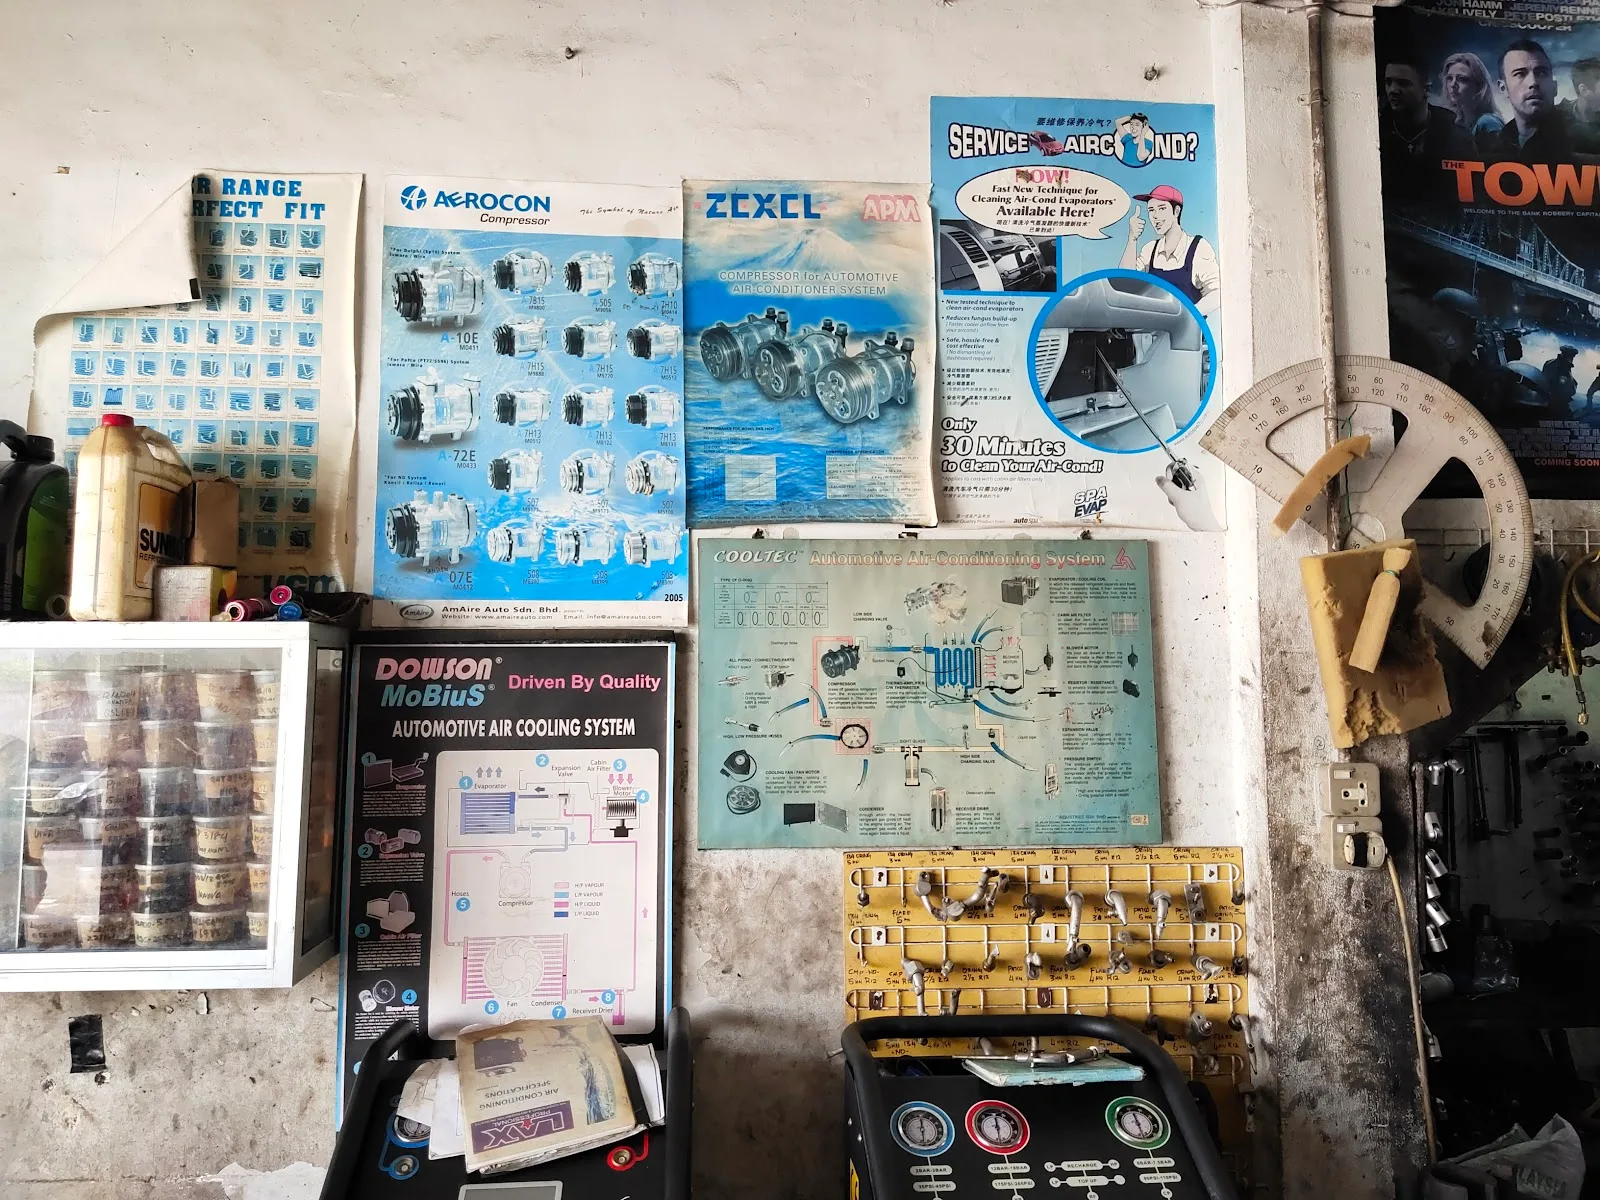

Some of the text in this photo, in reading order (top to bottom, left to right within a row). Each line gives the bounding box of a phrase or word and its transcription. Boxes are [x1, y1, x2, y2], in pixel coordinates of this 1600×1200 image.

[949, 122, 1030, 160] SERVICE
[1444, 161, 1465, 169] THE
[222, 178, 302, 198] RANGE
[1442, 160, 1600, 206] TOW
[992, 185, 1099, 196] Fast New Technique for
[433, 191, 551, 213] AEROCON
[971, 195, 1012, 205] Cleaning
[1013, 195, 1057, 205] Air-Cond
[284, 202, 326, 220] FIT
[862, 194, 922, 222] APM
[996, 206, 1095, 218] Available Here!
[480, 214, 551, 226] Compressor
[719, 271, 899, 283] COMPRESSOR for AUTOMOTIVE
[732, 285, 887, 296] AIR-CONDITIONER SYSTEM
[971, 315, 992, 323] fungus
[1347, 374, 1357, 382] 50
[1373, 376, 1384, 385] 60
[1295, 384, 1305, 393] 30
[1371, 388, 1385, 397] 120
[1270, 396, 1281, 406] 20
[1298, 394, 1312, 404] 150
[1424, 393, 1434, 403] 80
[1418, 403, 1432, 414] 100
[1248, 413, 1259, 422] 10
[1442, 411, 1455, 423] 90
[941, 417, 977, 433] Only
[1466, 426, 1478, 440] 100
[941, 435, 1065, 457] 30 Minutes
[941, 459, 1105, 474] to Clean Your Air-Cond!
[1253, 464, 1263, 474] 10
[1573, 459, 1600, 467] SOON
[1074, 486, 1108, 506] SPA
[1074, 499, 1108, 518] EVAP
[713, 550, 1106, 569] COOLTEC Automotive Air-Conditioning System
[664, 594, 684, 603] 2005
[508, 674, 661, 693] Driven By Quality
[392, 719, 636, 738] AUTOMOTIVE AIR COOLING SYSTEM
[498, 900, 534, 908] Compressor
[484, 1080, 551, 1099] SPECIFICATIONS
[479, 1087, 559, 1110] AIR CONDITIONING
[492, 1109, 551, 1127] PROFESSIONAL
